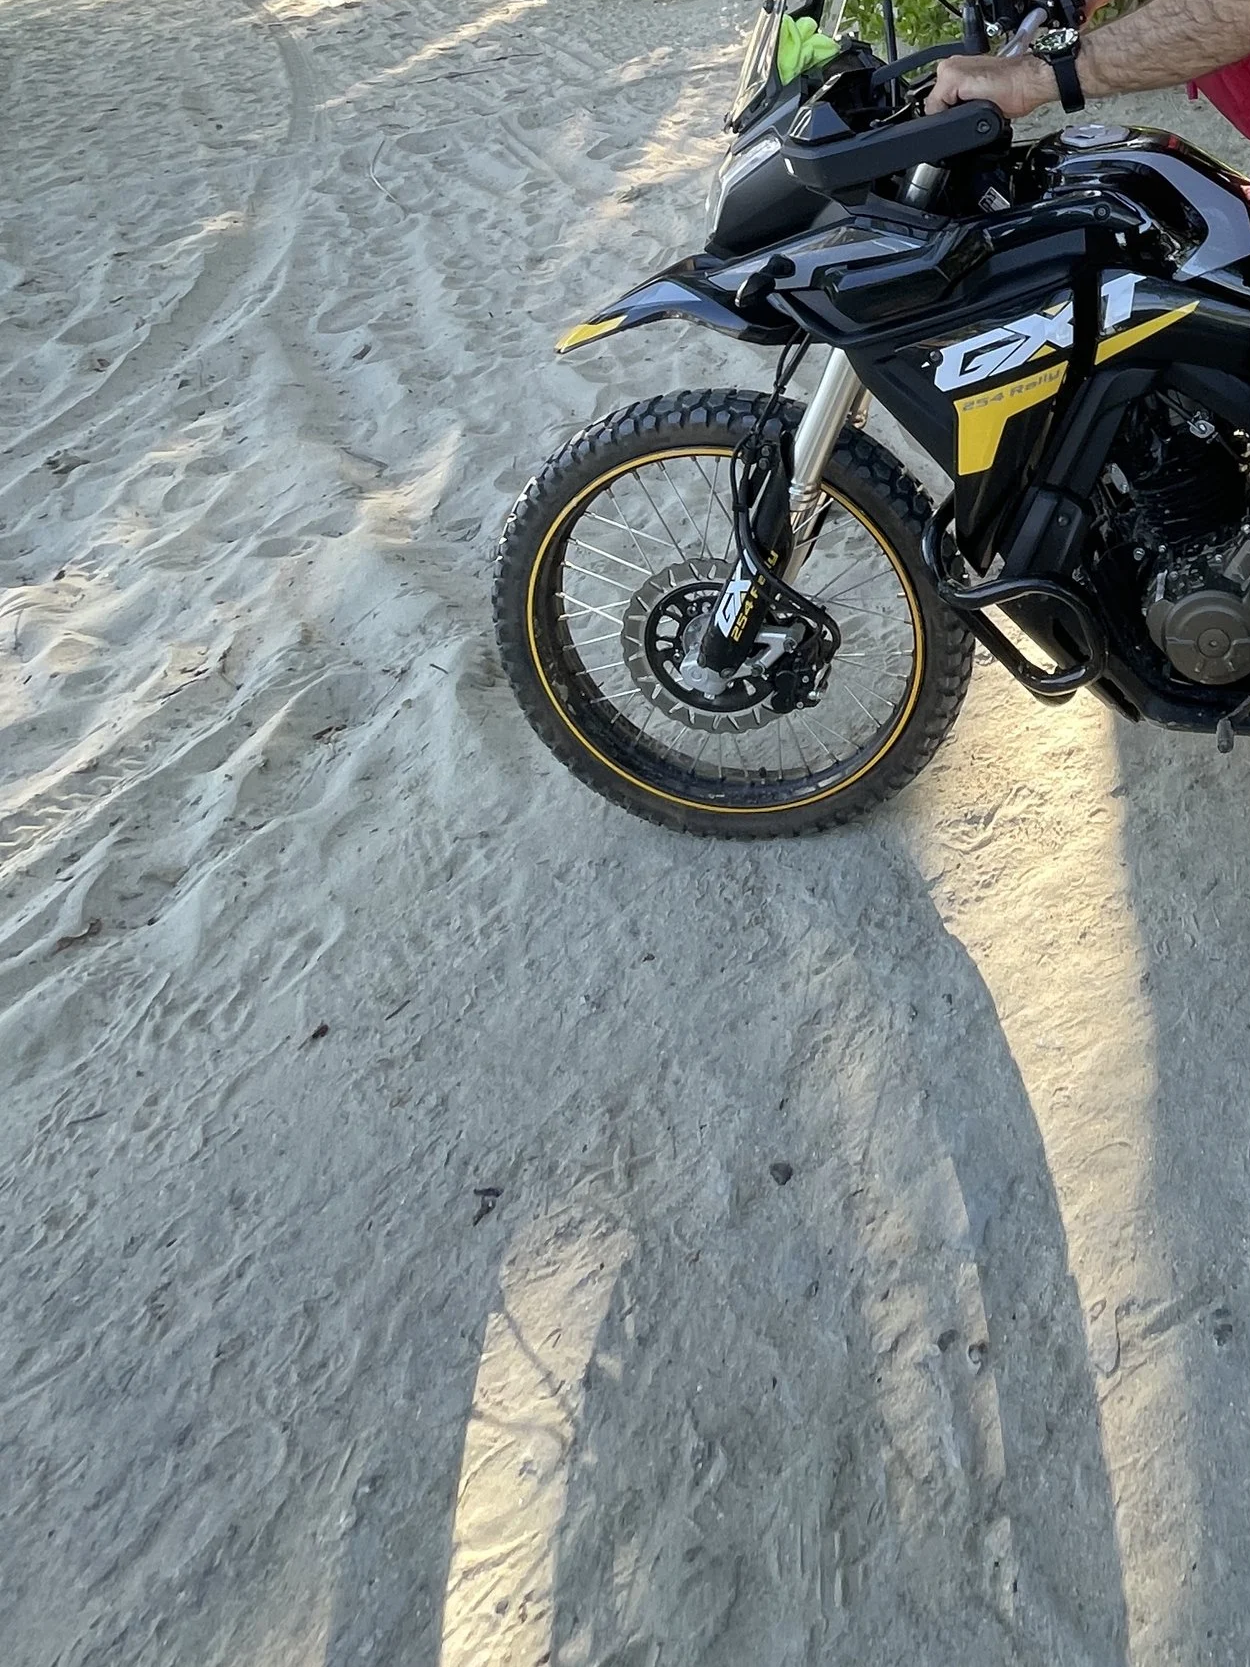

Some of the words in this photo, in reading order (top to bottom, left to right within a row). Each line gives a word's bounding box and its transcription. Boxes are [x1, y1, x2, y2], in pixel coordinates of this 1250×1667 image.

[963, 393, 1005, 411] 254
[1009, 369, 1060, 397] Rally
[730, 600, 754, 642] 254
